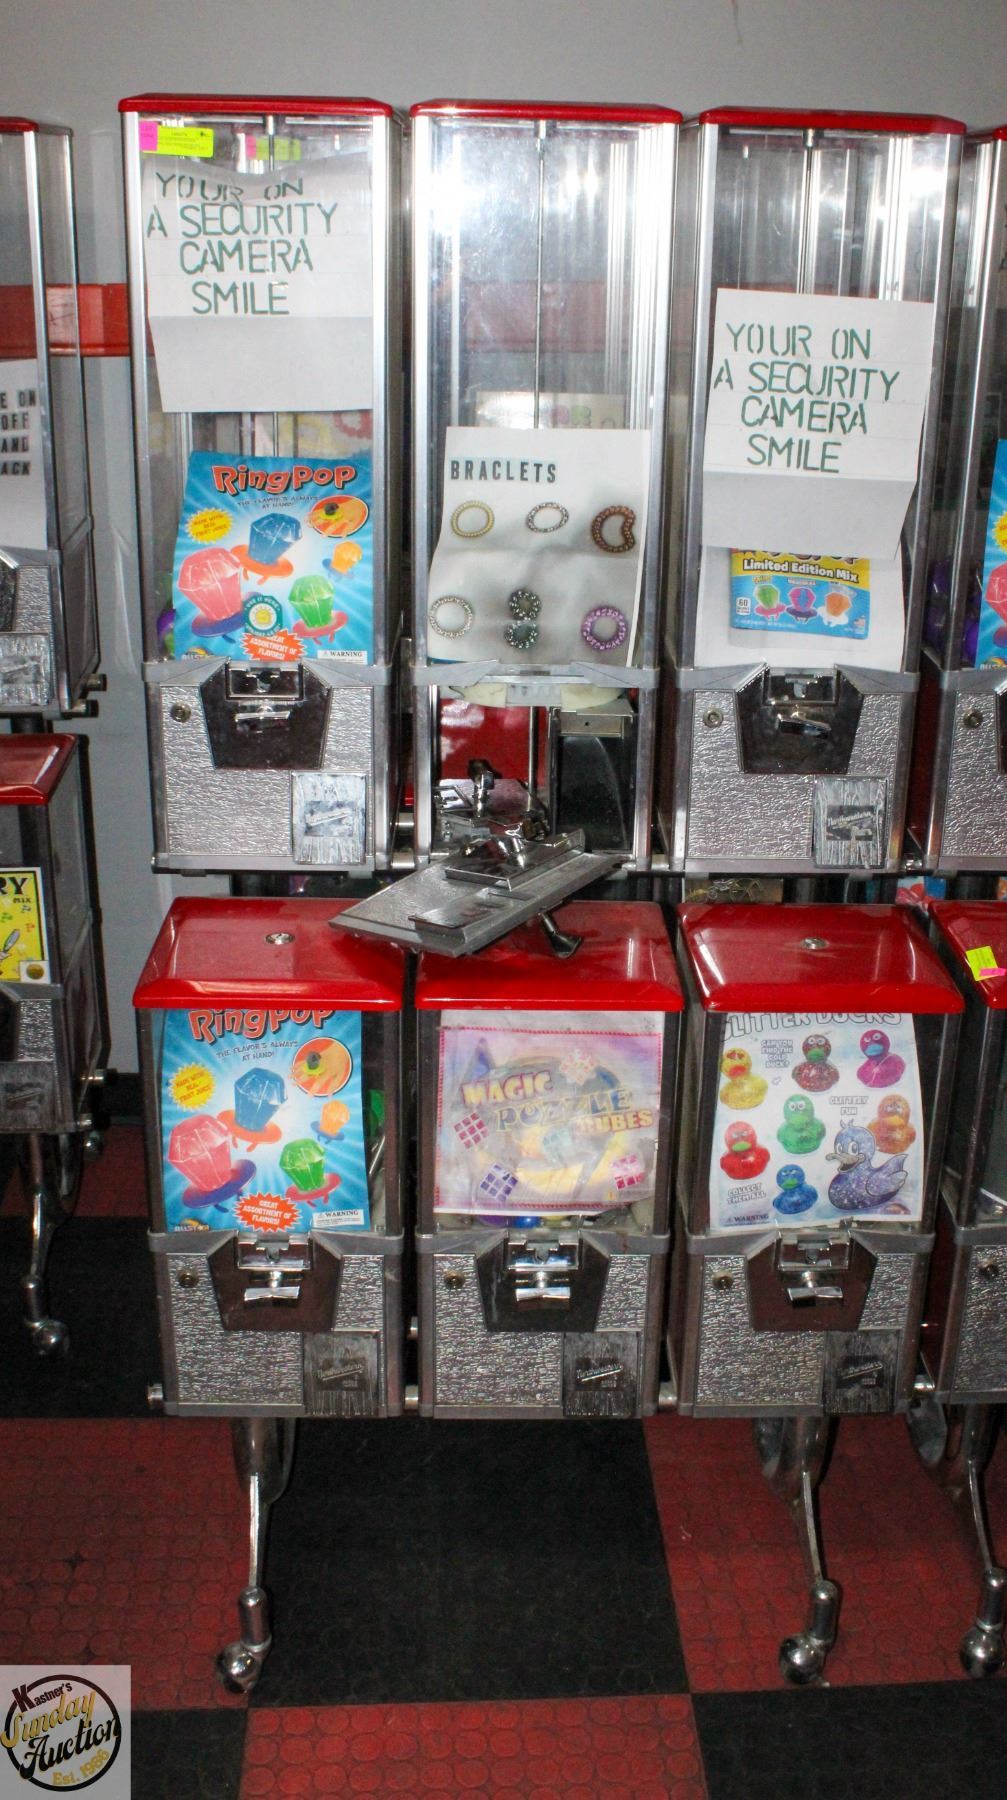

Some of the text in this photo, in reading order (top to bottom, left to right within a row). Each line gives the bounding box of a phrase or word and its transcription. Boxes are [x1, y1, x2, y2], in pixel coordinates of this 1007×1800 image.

[155, 171, 303, 201] YOUR ON
[146, 202, 338, 238] A SECURITY
[179, 239, 314, 275] CAMERA
[191, 281, 290, 315] SMILE
[726, 321, 872, 360] YOUR ON
[713, 358, 900, 401] A SECURITY
[1, 412, 30, 430] OFF
[740, 395, 868, 435] CAMERA
[746, 433, 842, 474] SMILE
[450, 459, 557, 484] BRACLETS
[743, 558, 859, 583] Limited Edition Mix
[460, 1070, 553, 1109] MAGIC
[728, 1182, 762, 1197] COLLECT
[324, 1209, 359, 1218] WARNING
